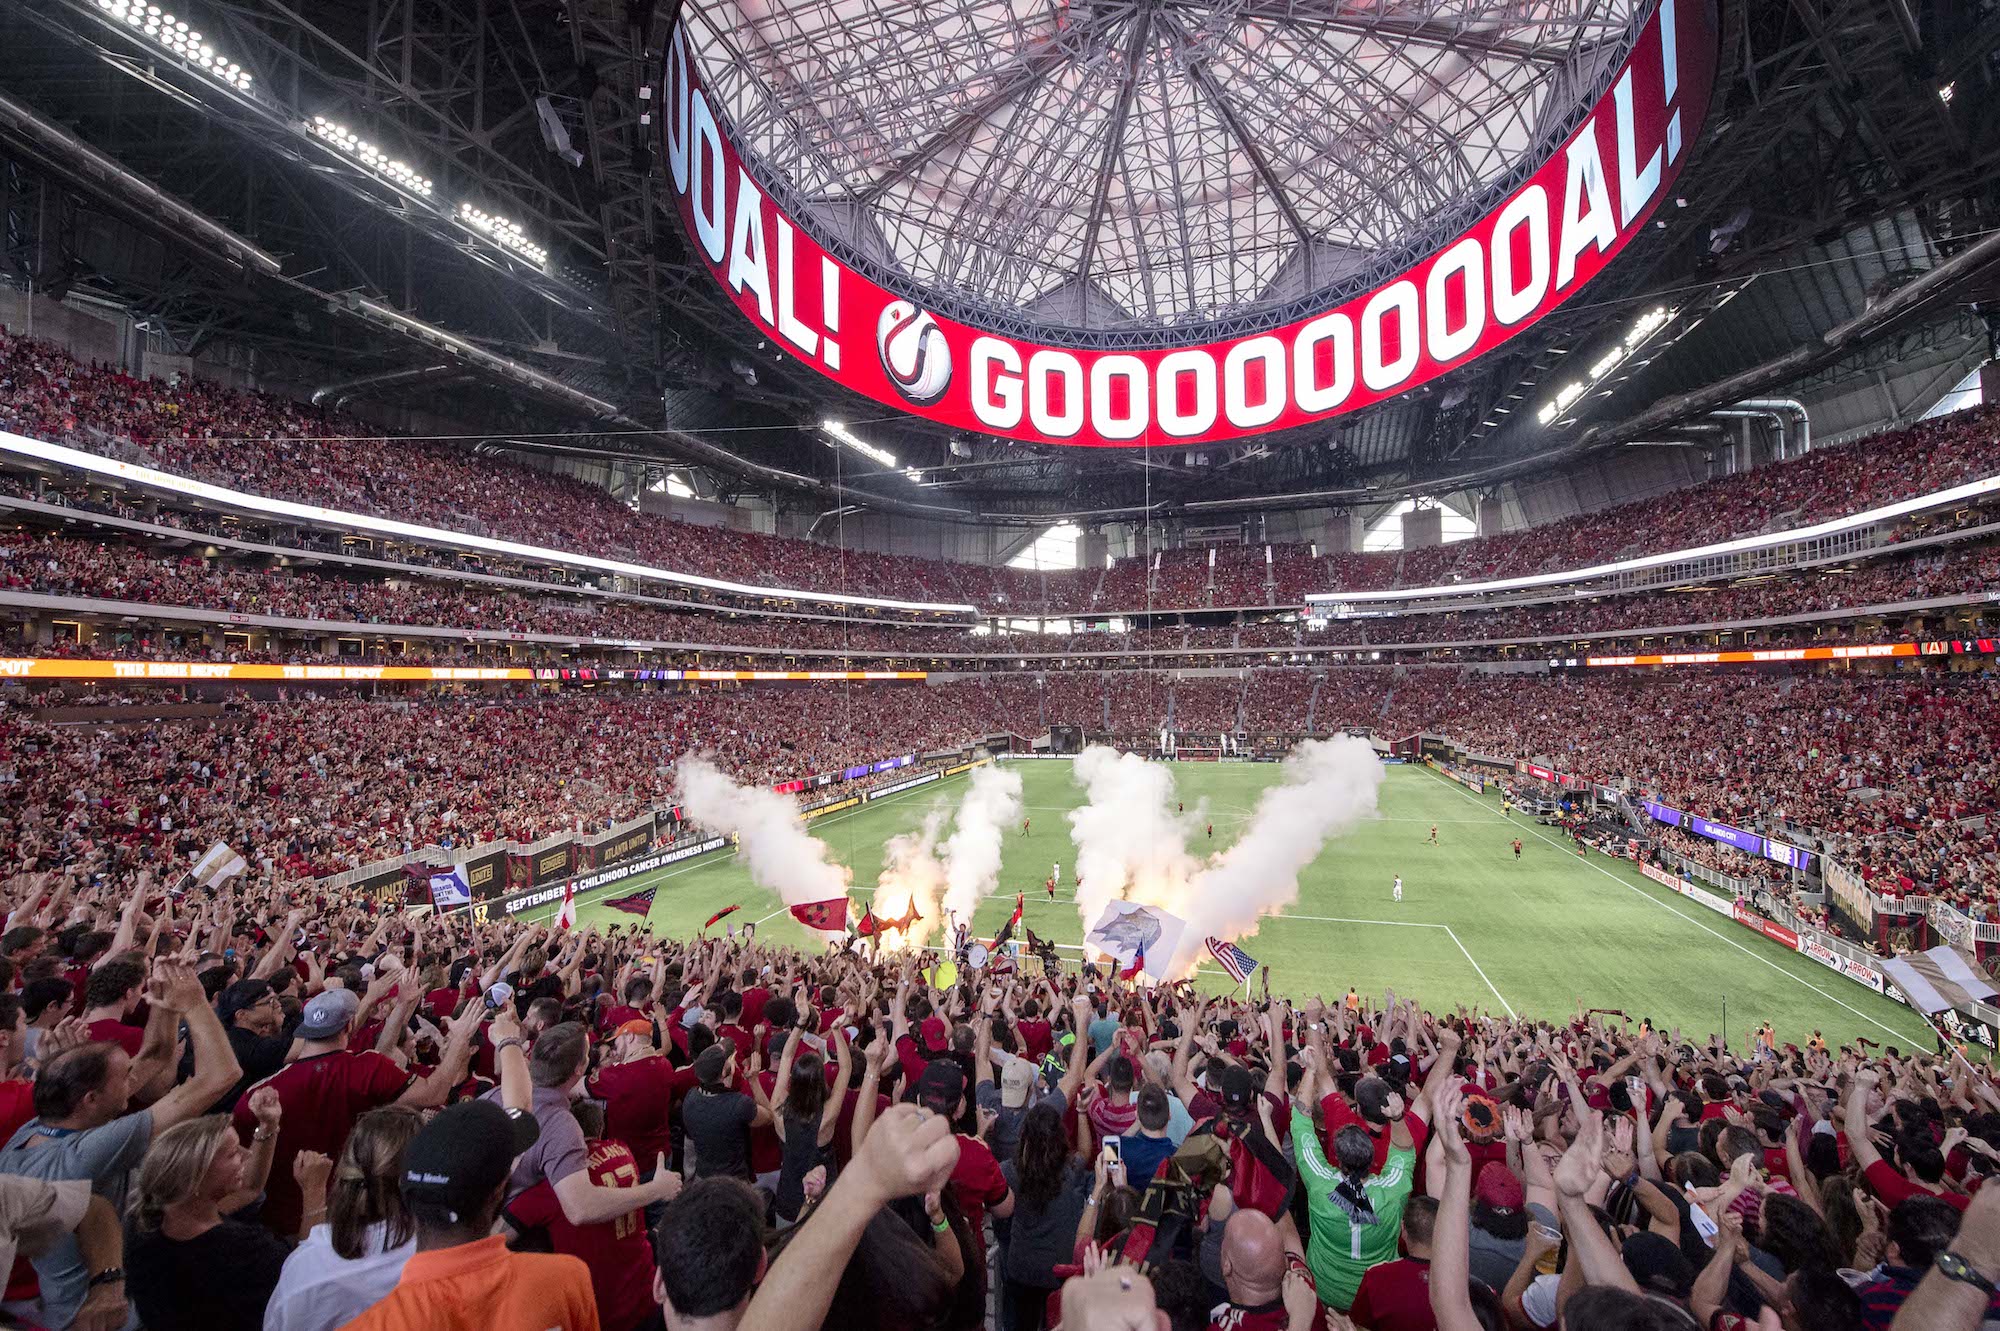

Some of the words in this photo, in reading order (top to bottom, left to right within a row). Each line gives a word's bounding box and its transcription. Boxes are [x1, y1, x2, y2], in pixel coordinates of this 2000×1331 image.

[0, 660, 36, 675] POT
[113, 663, 145, 676] THE
[150, 663, 188, 676] HOME
[190, 664, 233, 677] DEPOT
[1683, 816, 1689, 828] 2
[1704, 824, 1725, 839] ORLANDO
[1725, 830, 1737, 842] CITY
[604, 841, 628, 862] ATLANTA
[628, 832, 648, 853] UNITED
[472, 868, 492, 884] UNITE
[505, 886, 567, 914] SEPTEMBER
[579, 867, 628, 890] CHILDHOOD
[629, 857, 660, 875] CANCER
[661, 844, 702, 865] AWARENESS
[702, 837, 725, 853] MONTH
[1642, 863, 1679, 889] ADVOCARE
[1809, 942, 1831, 960] ARROW
[1848, 961, 1873, 980] ARROW
